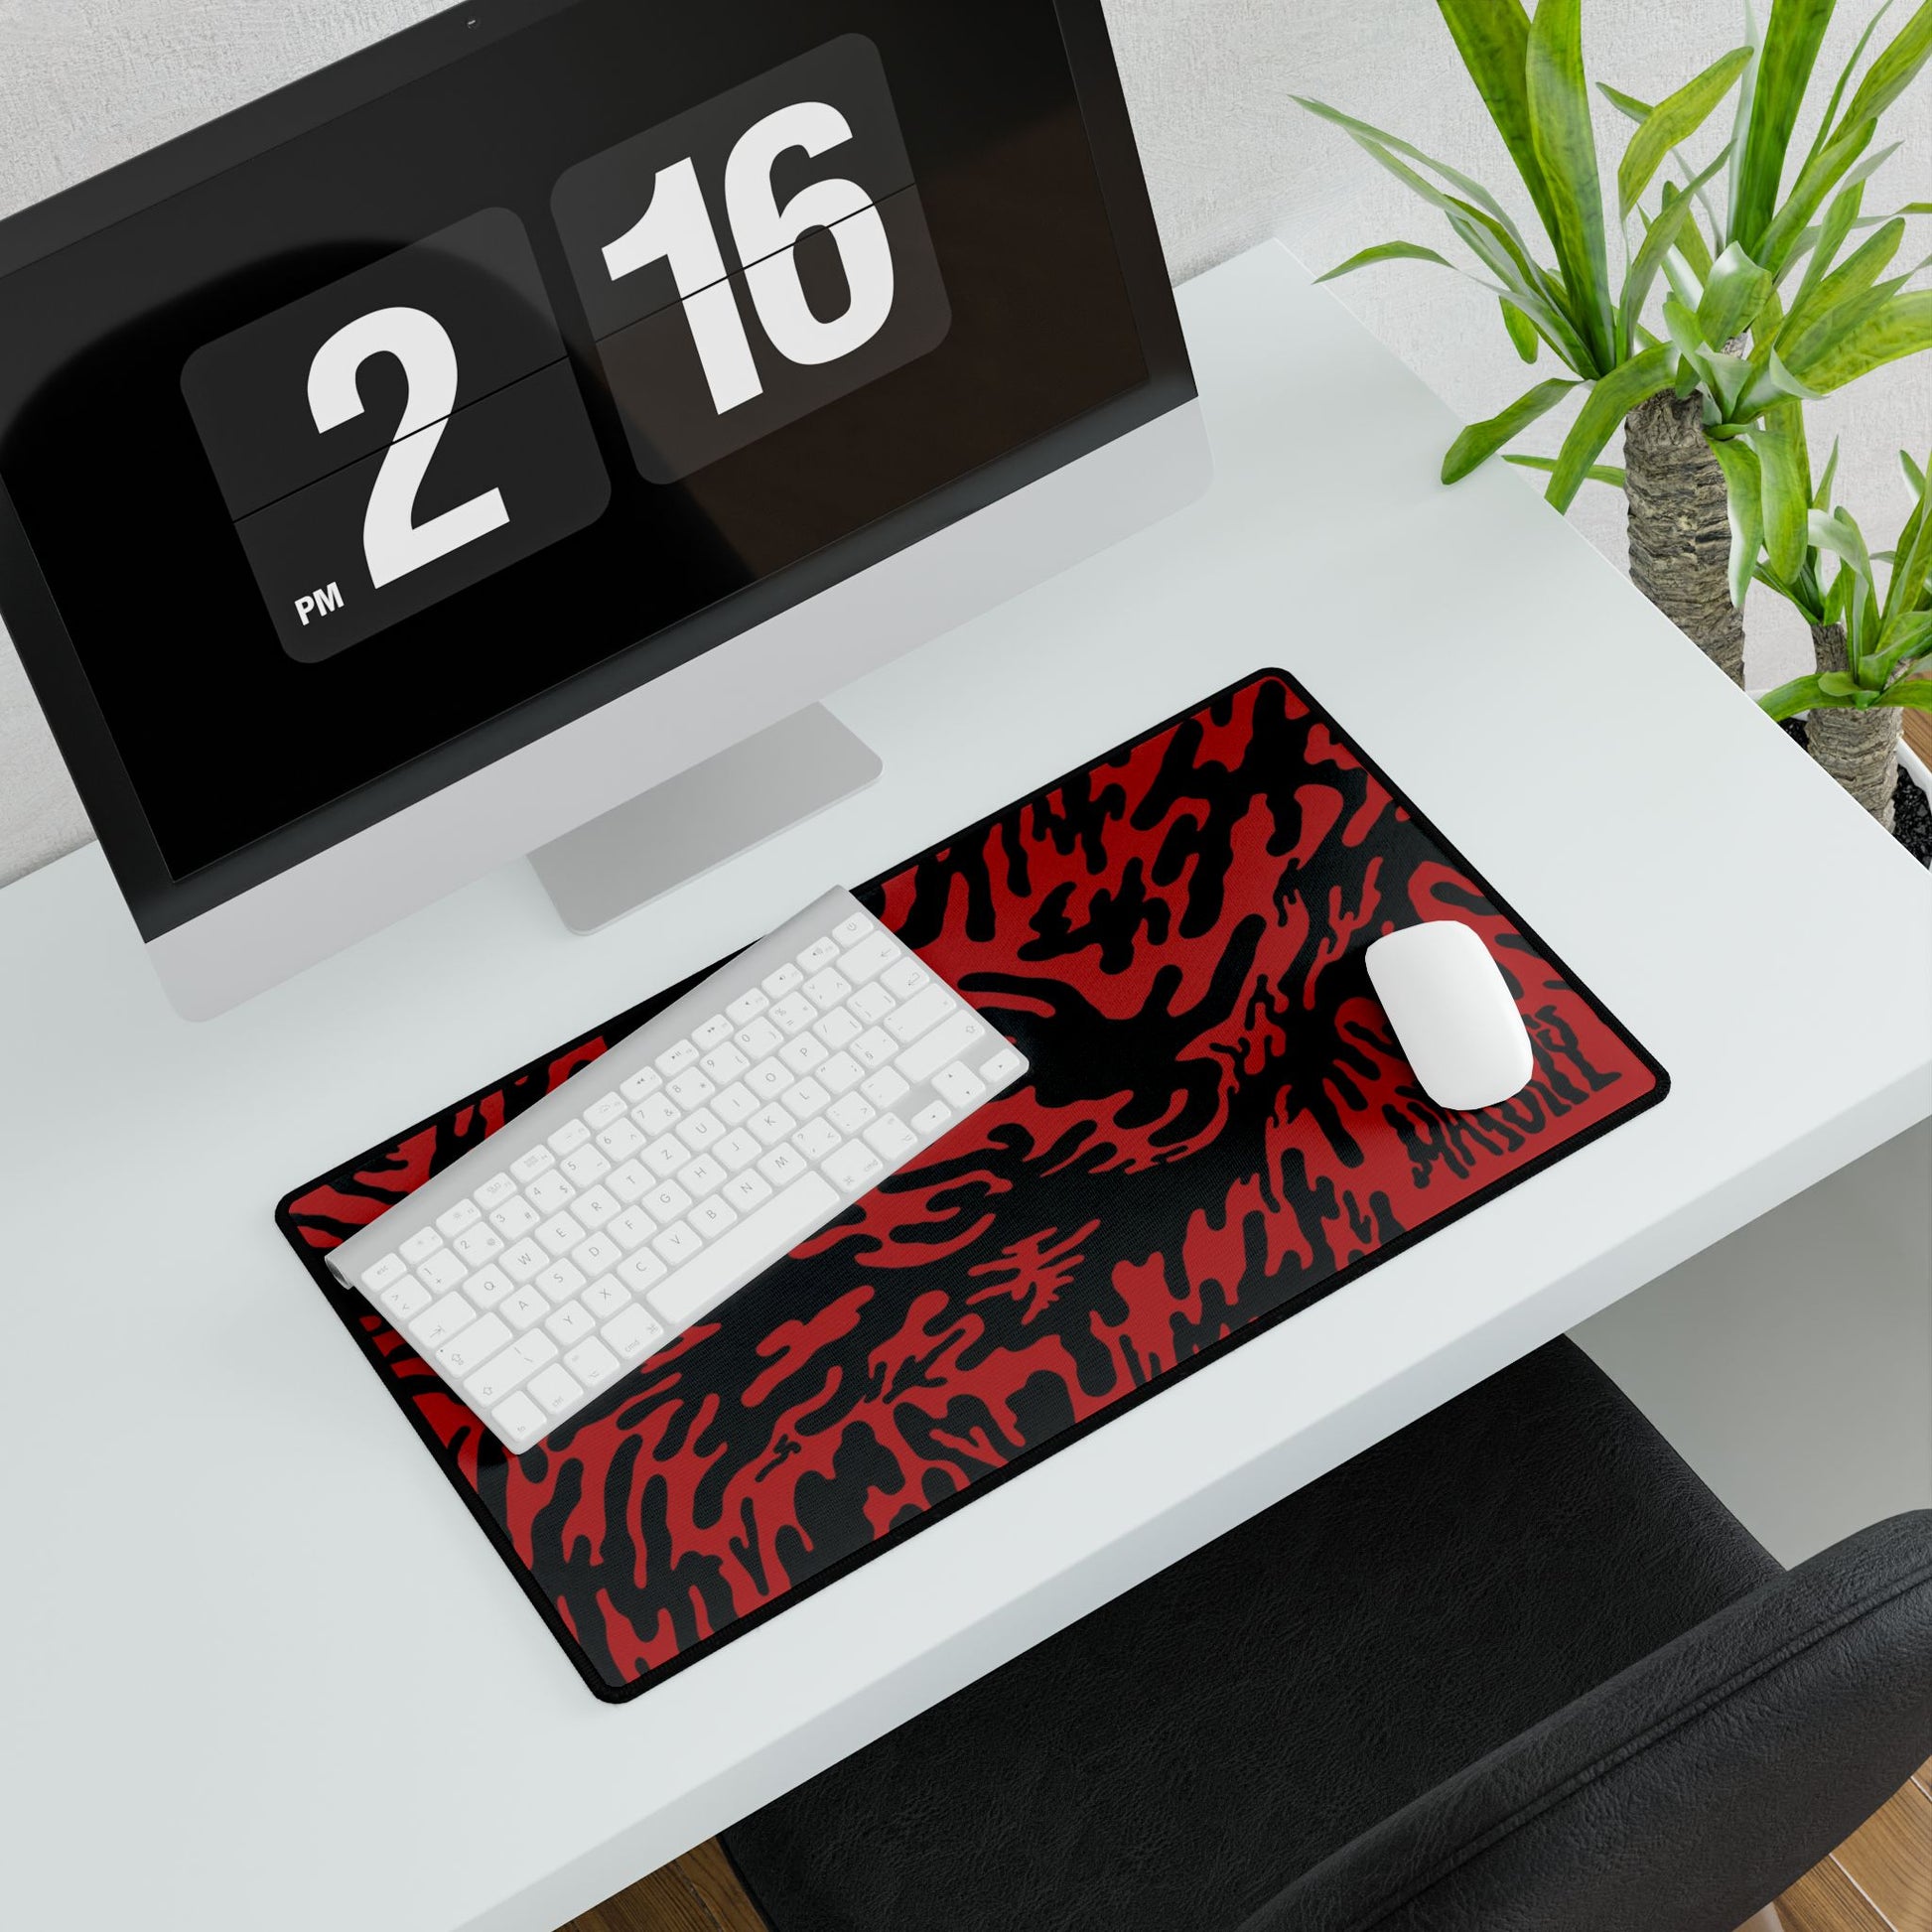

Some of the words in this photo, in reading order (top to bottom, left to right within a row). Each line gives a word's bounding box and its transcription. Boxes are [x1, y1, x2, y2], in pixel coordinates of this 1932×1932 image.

[308, 307, 509, 590] 2
[602, 102, 894, 414] 16
[295, 582, 344, 625] PM
[800, 1048, 808, 1057] P
[706, 1059, 715, 1068] 9
[765, 1073, 776, 1082] O
[672, 1085, 681, 1093] 8
[799, 1092, 810, 1100] L
[637, 1110, 645, 1119] 7
[764, 1116, 776, 1126] K
[695, 1123, 707, 1134] U
[603, 1136, 612, 1144] 6
[732, 1142, 739, 1151] J
[661, 1149, 673, 1160] Z
[567, 1161, 577, 1171] 5
[775, 1156, 788, 1168] M
[694, 1167, 707, 1178] H
[626, 1175, 635, 1184] T
[740, 1182, 753, 1193] N
[660, 1193, 671, 1203] G
[591, 1202, 602, 1211] R
[496, 1214, 506, 1223] 3
[706, 1210, 717, 1220] B
[625, 1220, 633, 1230] F
[556, 1228, 567, 1238] E
[670, 1235, 680, 1244] V
[460, 1240, 470, 1250] 2
[588, 1247, 600, 1257] D
[518, 1253, 531, 1265] W
[636, 1261, 647, 1272] C
[553, 1273, 564, 1283] S
[484, 1281, 496, 1291] Q
[599, 1288, 612, 1300] X
[519, 1300, 529, 1311] A
[563, 1315, 573, 1325] Y
